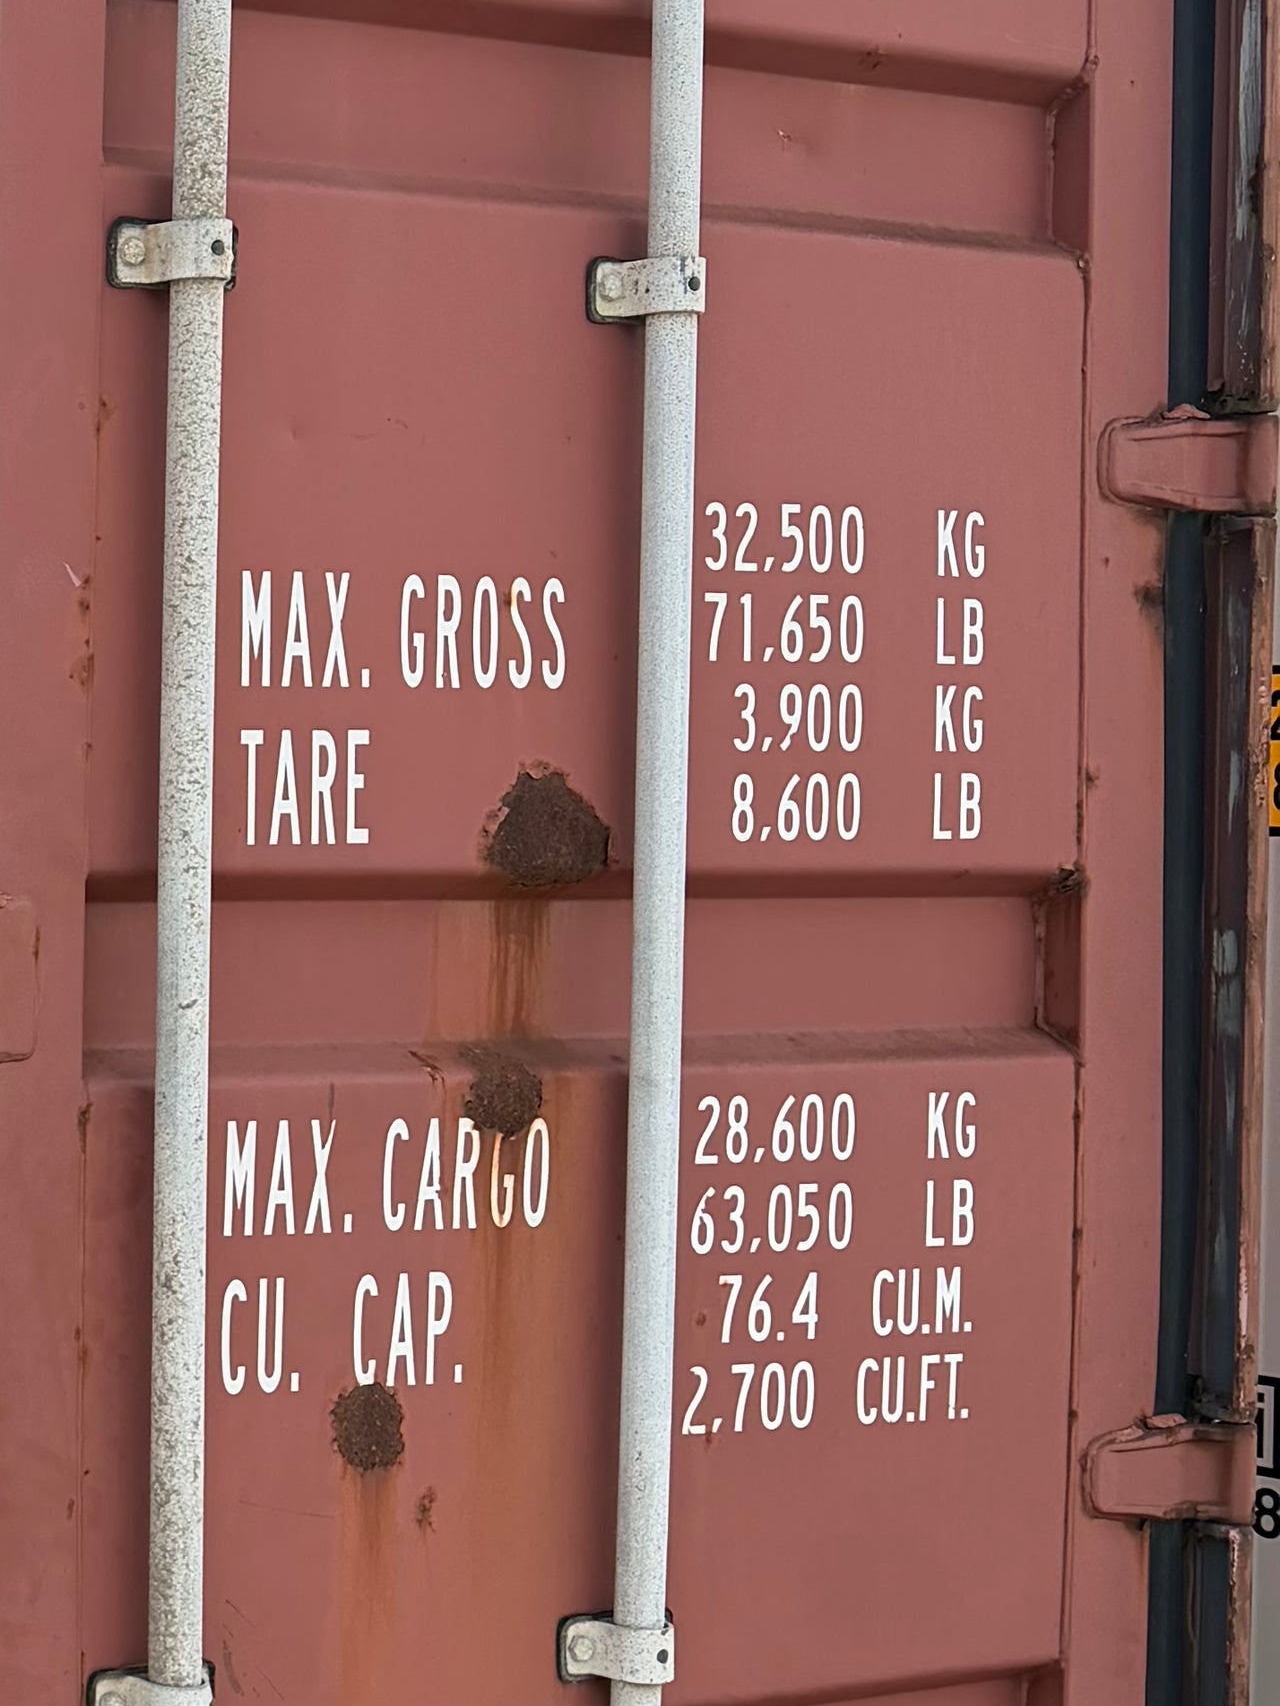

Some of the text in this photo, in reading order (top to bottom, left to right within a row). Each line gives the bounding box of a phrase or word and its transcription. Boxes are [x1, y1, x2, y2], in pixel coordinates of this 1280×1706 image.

[704, 501, 985, 578] 32,500 KG
[241, 570, 566, 690] MAX. GROSS
[704, 592, 984, 665] 71,650 LB
[733, 683, 984, 753] 3,900 KG
[240, 729, 370, 846] TARE
[731, 772, 981, 842] 8,600 LB
[694, 1091, 976, 1165] 28,600 KG
[223, 1117, 550, 1237] MAX. CARGO
[690, 1179, 974, 1255] 63,050 LB
[221, 1271, 463, 1395] CU. CAP.
[718, 1266, 972, 1344] 76.4 CU.M.
[681, 1353, 969, 1435] 2,700 CU.FT.
